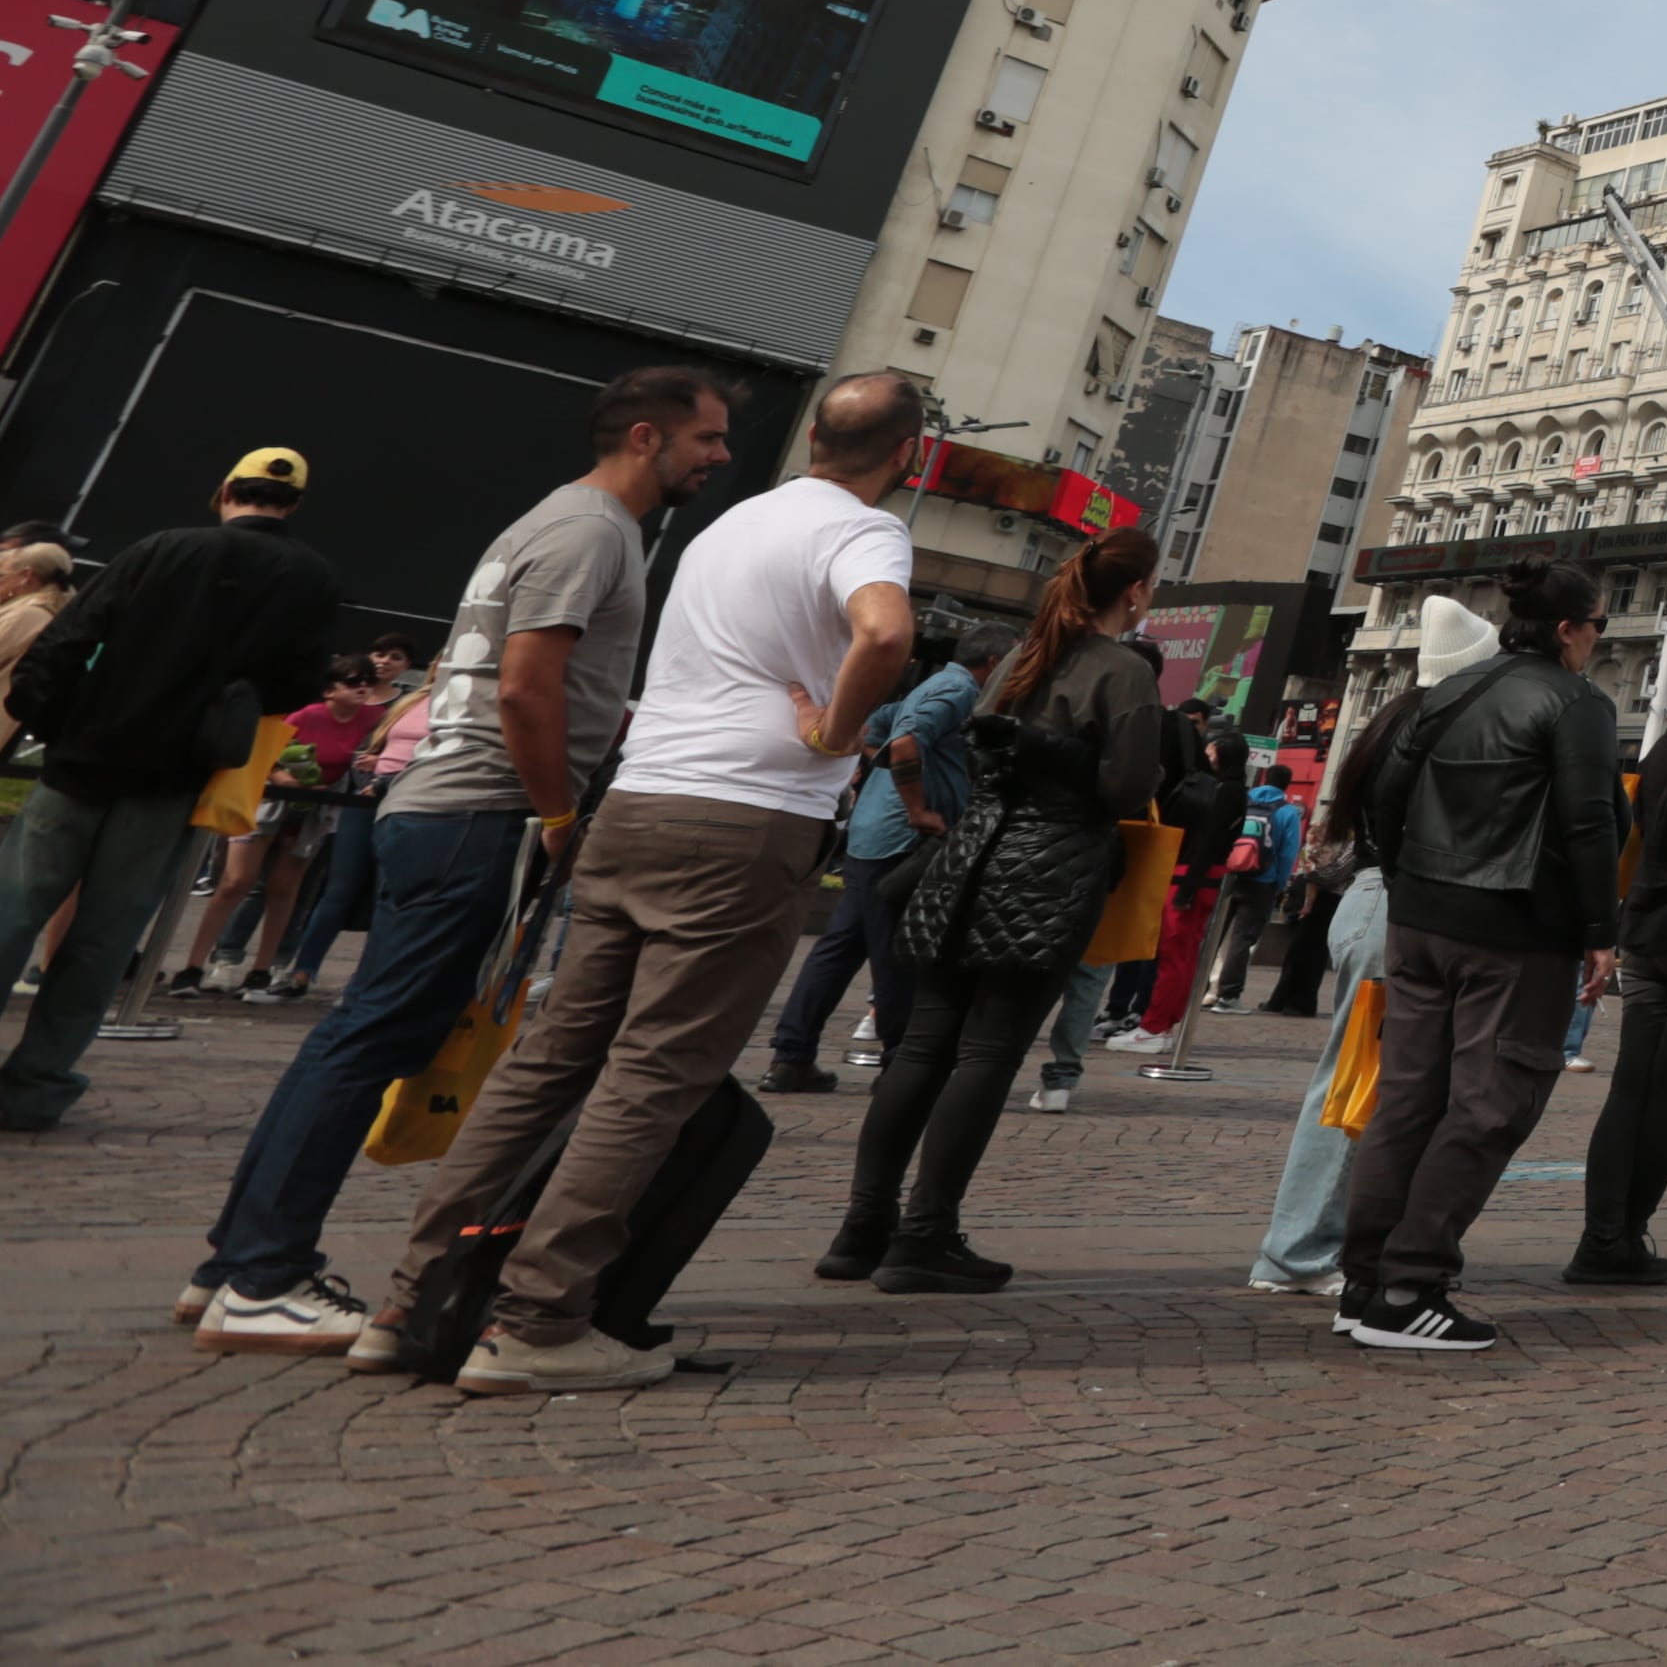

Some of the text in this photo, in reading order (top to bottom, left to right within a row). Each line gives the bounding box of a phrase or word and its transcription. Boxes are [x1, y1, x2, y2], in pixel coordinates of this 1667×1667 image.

[433, 32, 472, 49] Ciudad
[390, 189, 616, 268] Atacama
[402, 227, 587, 280] Buenos Aires, Argentina
